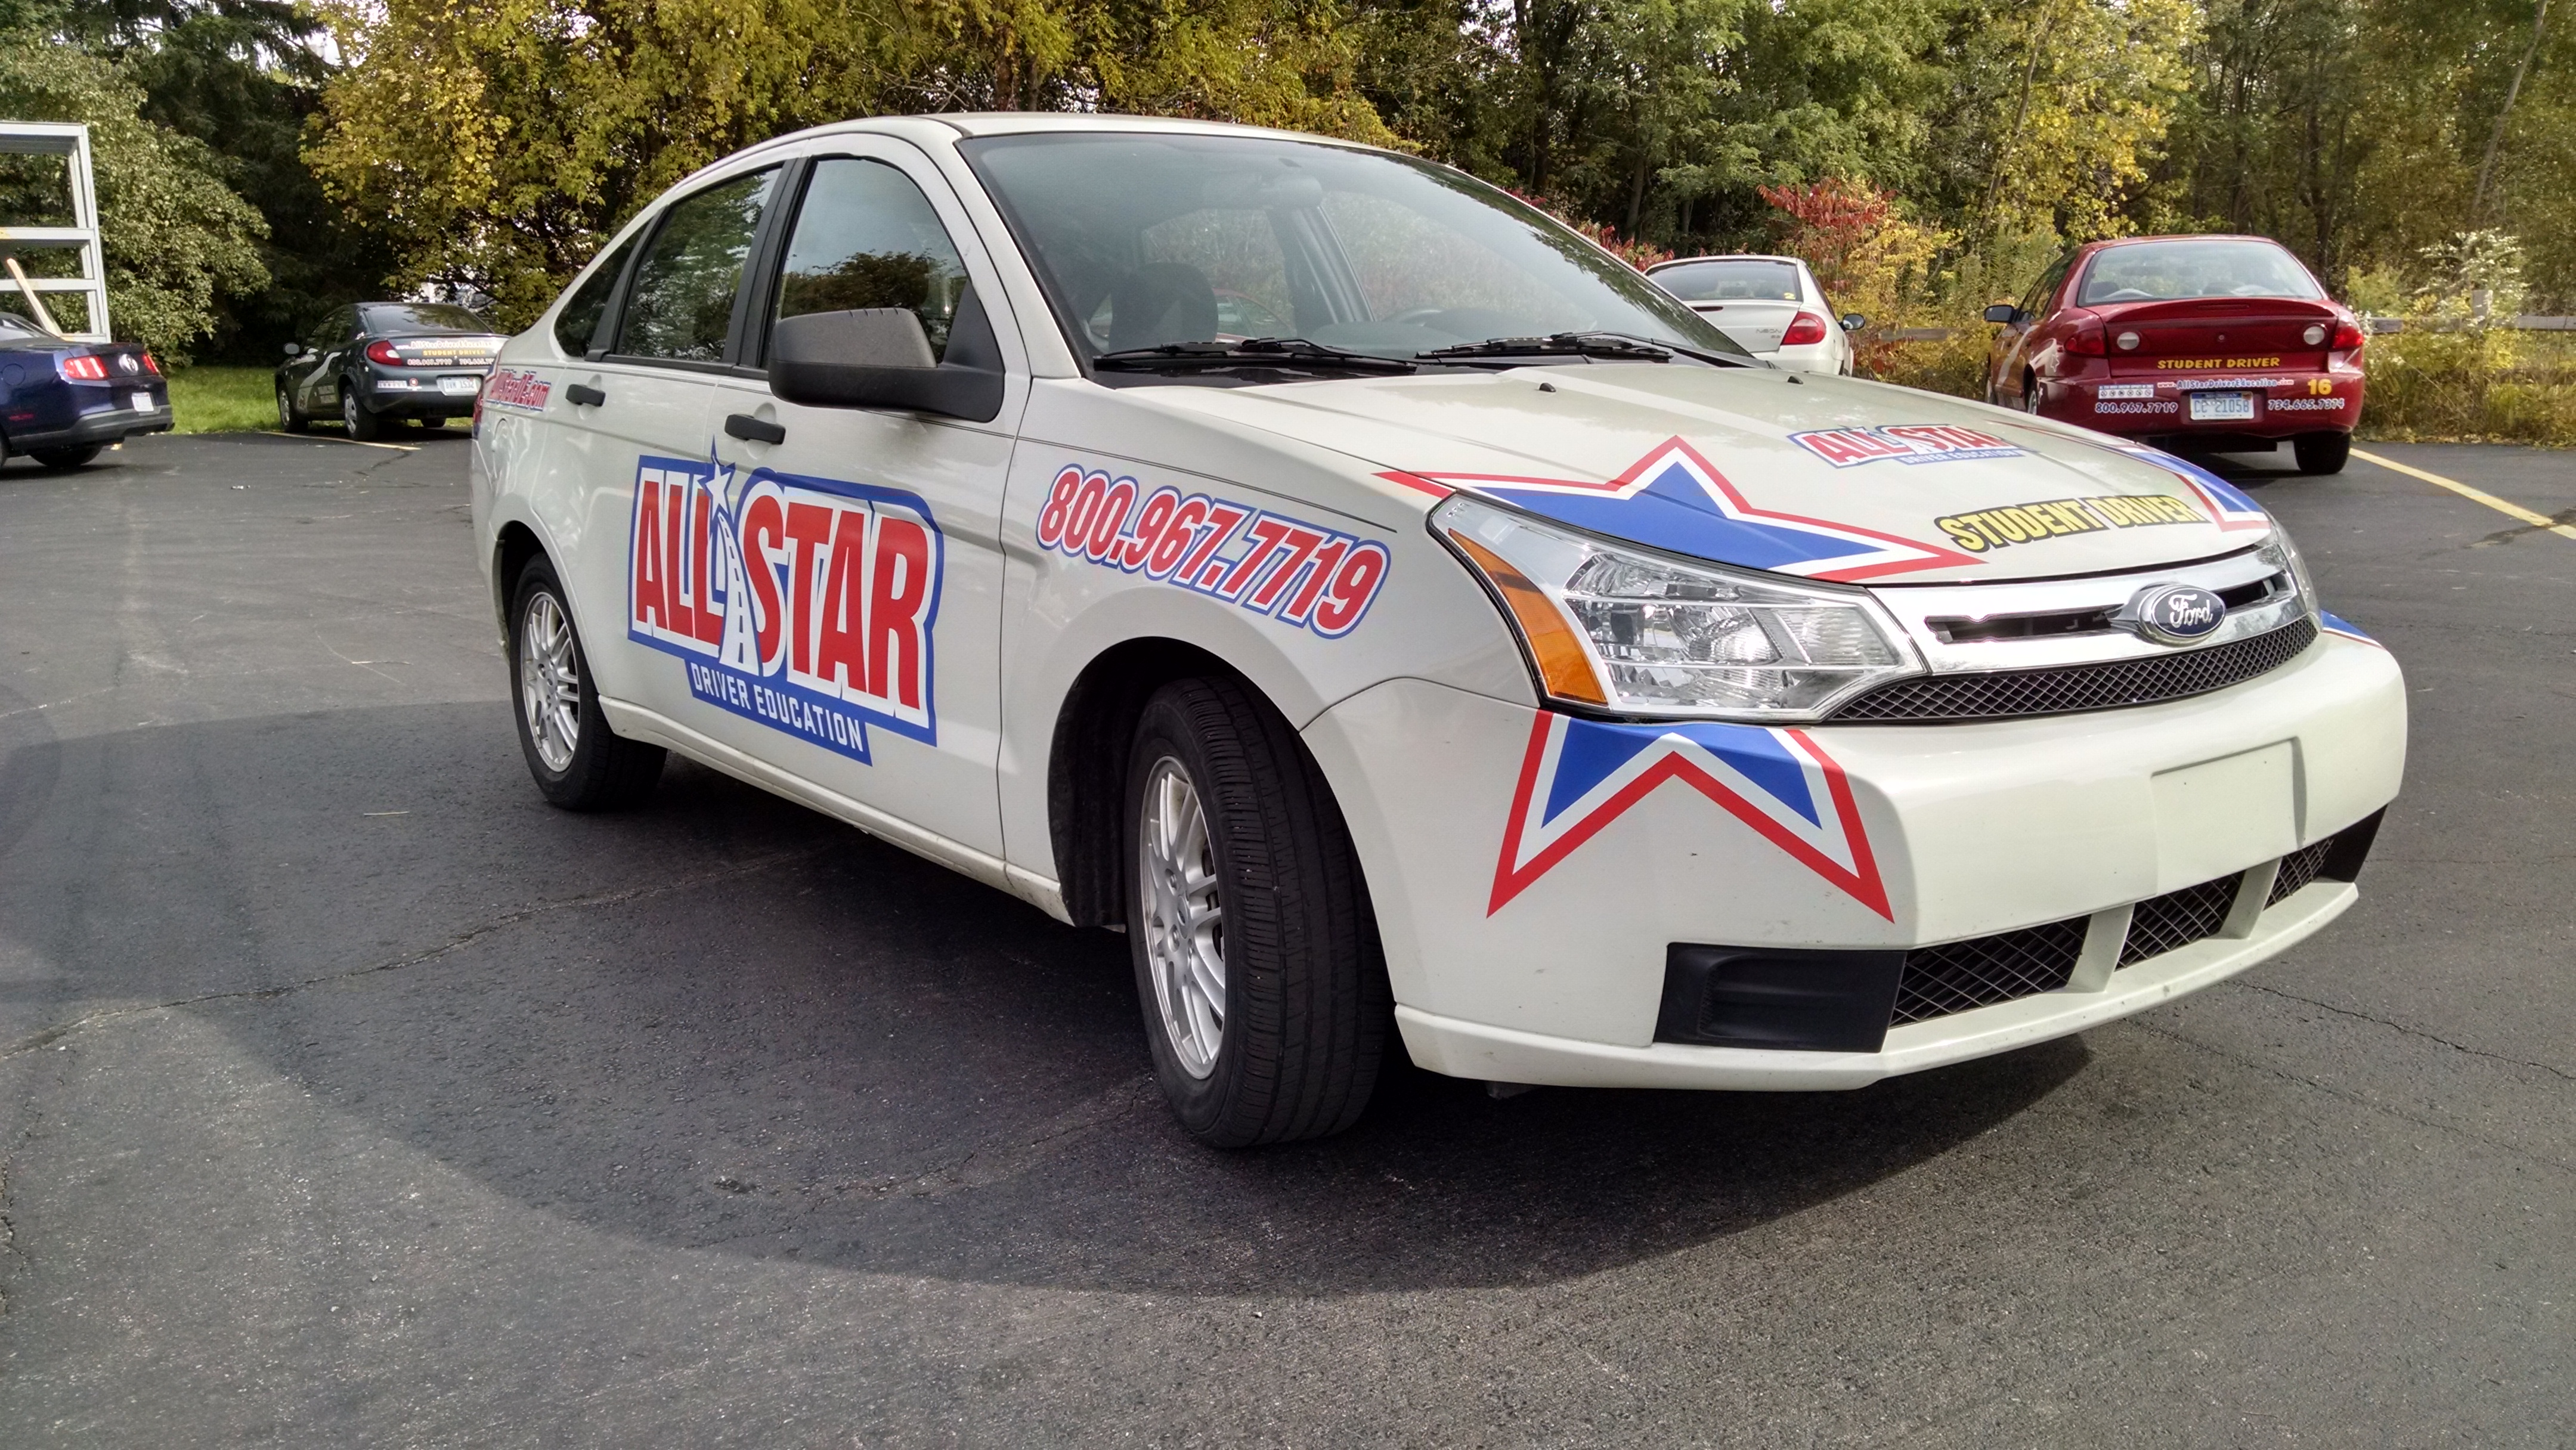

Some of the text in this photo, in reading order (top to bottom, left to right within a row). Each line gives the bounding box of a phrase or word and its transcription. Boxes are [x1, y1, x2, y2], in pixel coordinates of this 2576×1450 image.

[2157, 358, 2280, 369] STUDENT DRIVER
[2307, 378, 2332, 395] 16
[2095, 402, 2178, 413] 800.967.7719
[2268, 398, 2345, 410] 734.665.7374
[1800, 430, 1912, 463] ALL
[1899, 449, 2020, 464] DRIVER EDUCATION
[1939, 495, 2206, 551] STUDENT DRIVER
[1038, 469, 1385, 632] 800.967.7719
[634, 477, 929, 711] ALL STAR
[2169, 594, 2213, 628] Ford
[691, 662, 863, 752] DRIVER EDUCATION
